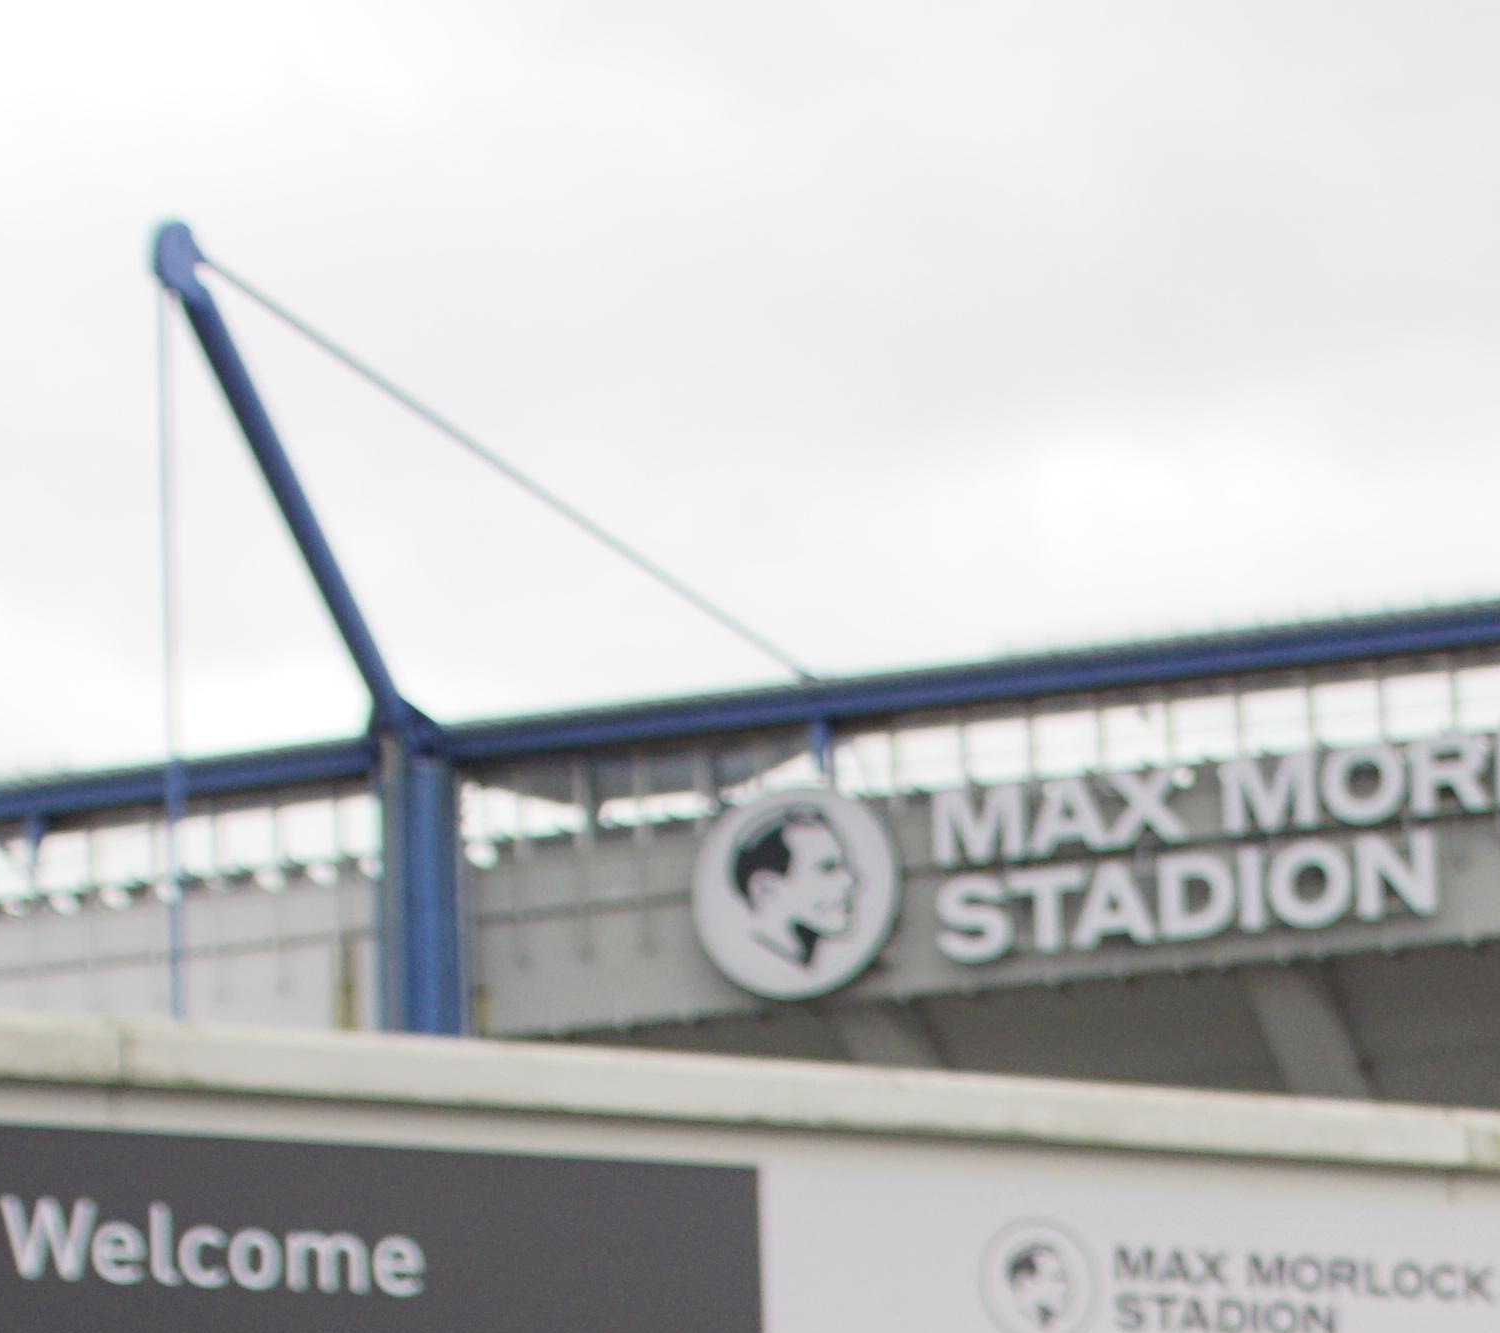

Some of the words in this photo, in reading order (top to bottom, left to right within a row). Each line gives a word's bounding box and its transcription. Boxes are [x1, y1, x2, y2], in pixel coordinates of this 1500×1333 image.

[933, 766, 1204, 866] MAX
[935, 828, 1441, 964] STADION
[1, 1195, 425, 1298] Welcome
[1114, 1246, 1227, 1287] MAX
[1248, 1254, 1493, 1302] MORLOCK
